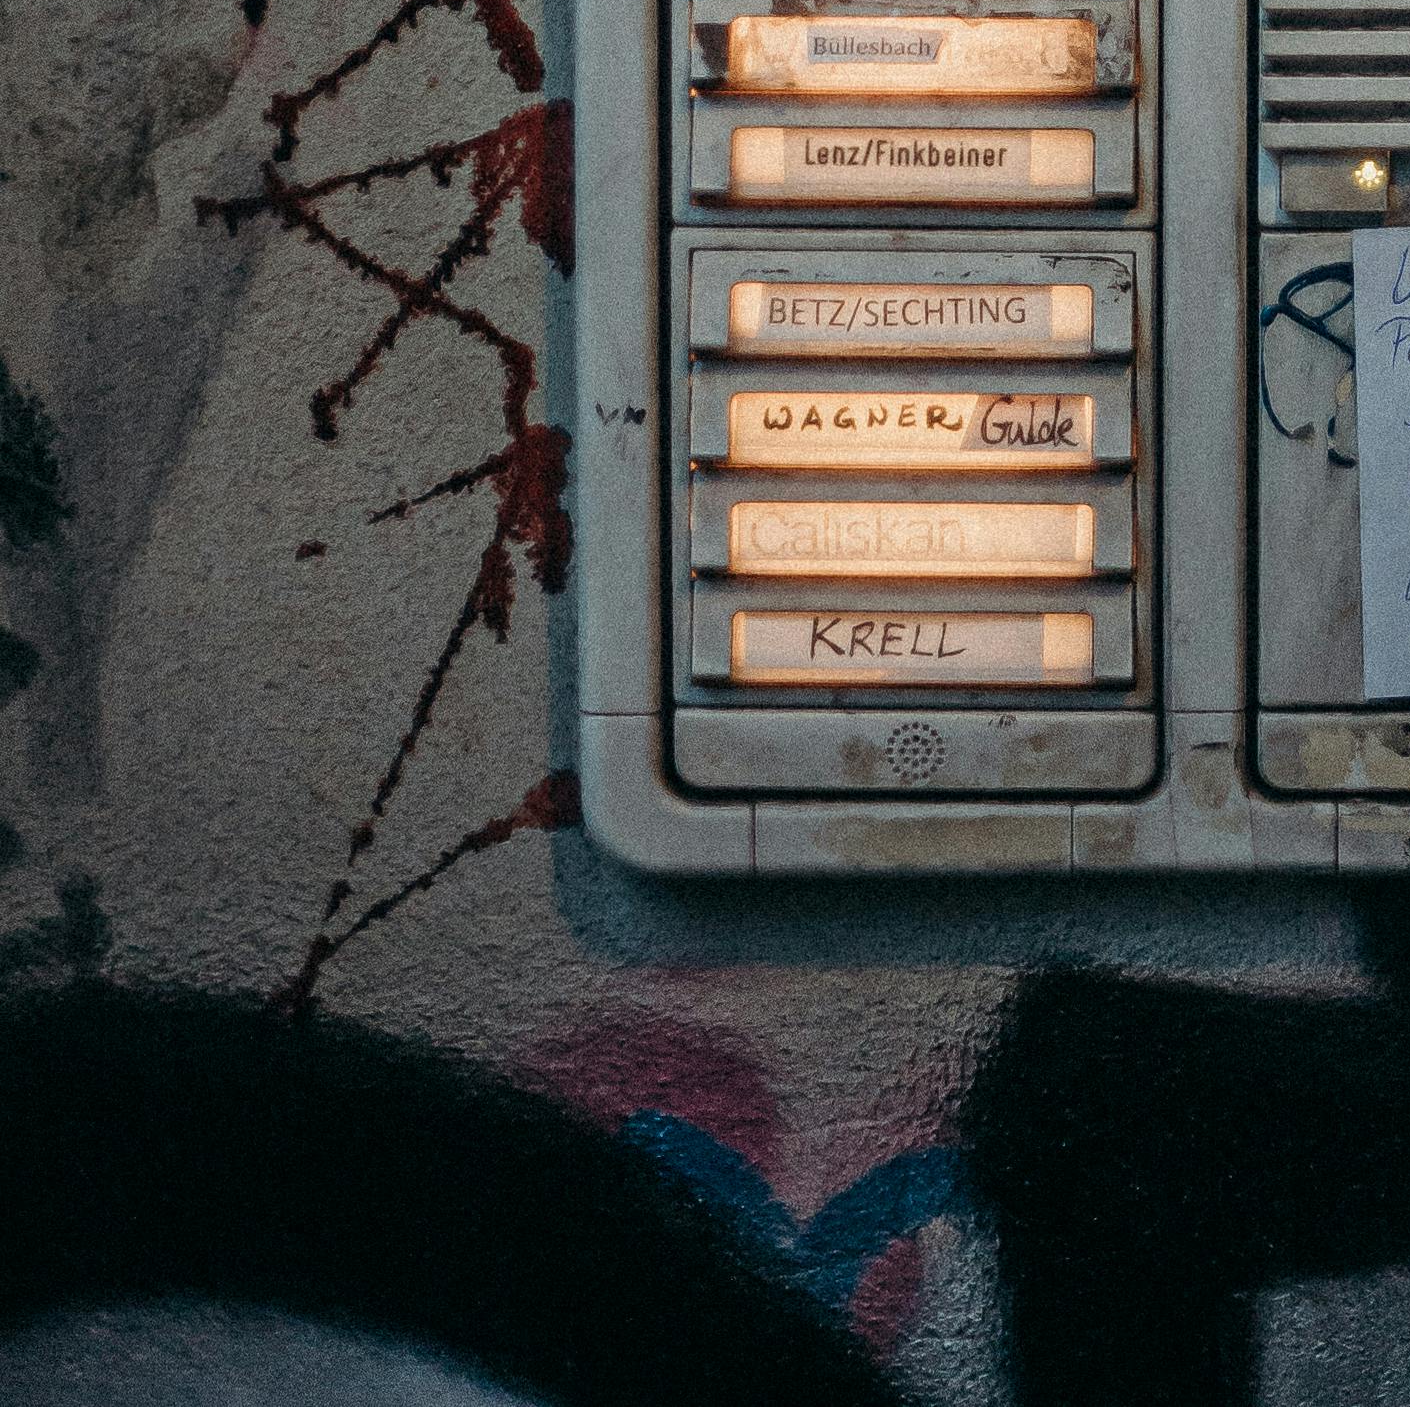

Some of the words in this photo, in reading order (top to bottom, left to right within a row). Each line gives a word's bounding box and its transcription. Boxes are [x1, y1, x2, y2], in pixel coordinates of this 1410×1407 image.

[804, 139, 1008, 168] Lenz/Finkbeiner
[768, 296, 1027, 332] BETZ/SECHTING
[810, 617, 968, 659] KRELL
